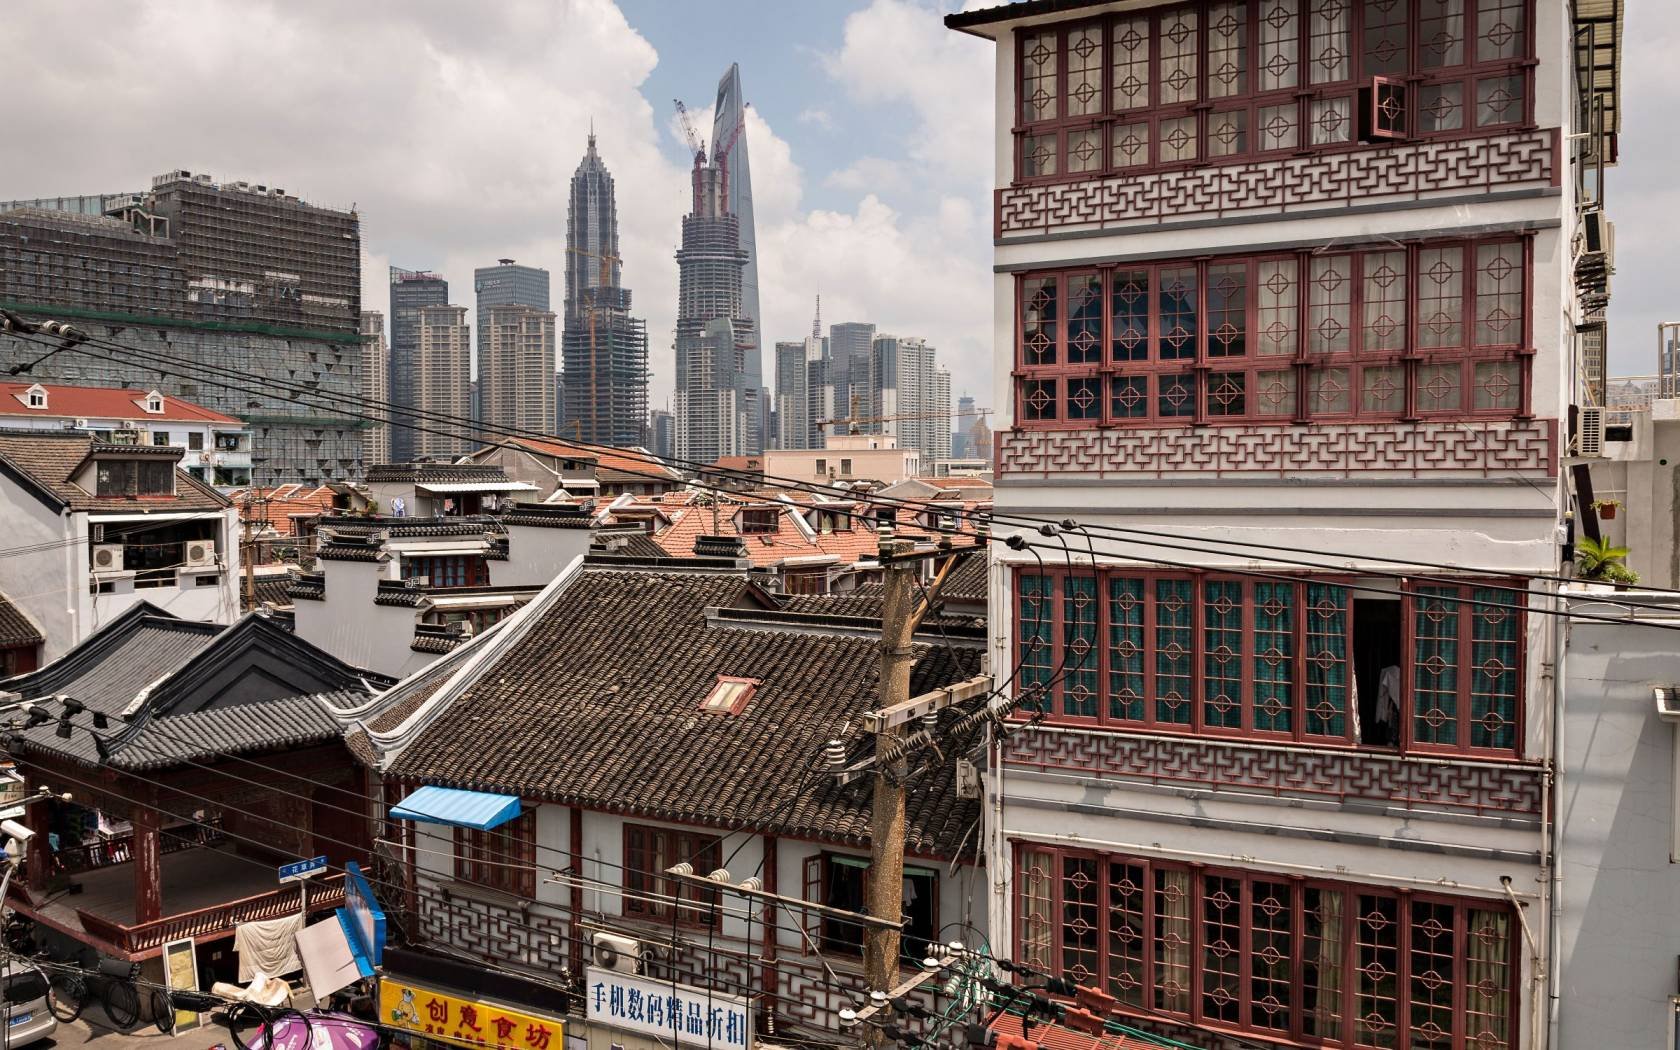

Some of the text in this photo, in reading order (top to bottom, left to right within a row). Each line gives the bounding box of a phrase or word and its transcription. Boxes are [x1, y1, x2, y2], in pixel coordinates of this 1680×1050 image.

[425, 998, 553, 1050] 创意食坊
[591, 982, 745, 1045] 手机数码精品折扣
